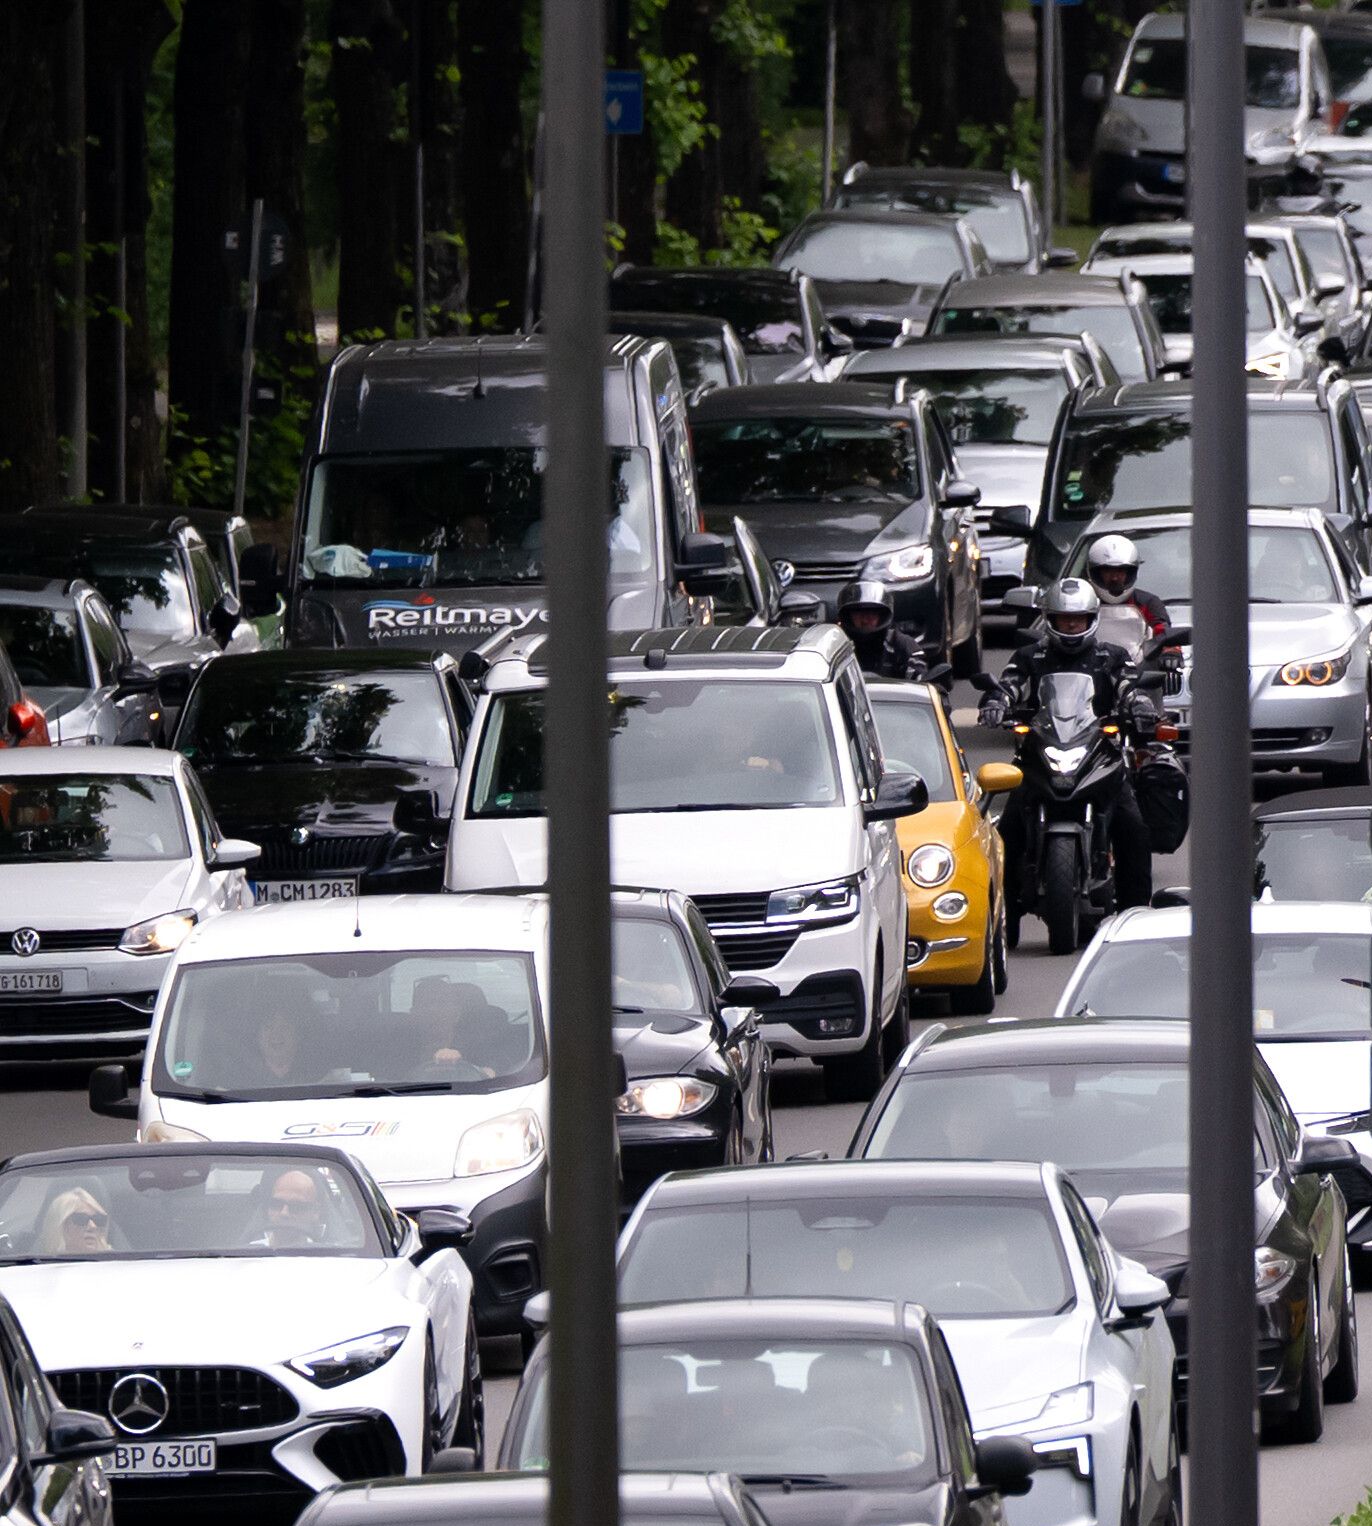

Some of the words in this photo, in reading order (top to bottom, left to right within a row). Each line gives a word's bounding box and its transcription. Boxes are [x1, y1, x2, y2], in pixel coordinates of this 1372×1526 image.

[369, 627, 429, 640] WASSER
[115, 1446, 146, 1469] BP
[152, 1444, 212, 1468] 6300
